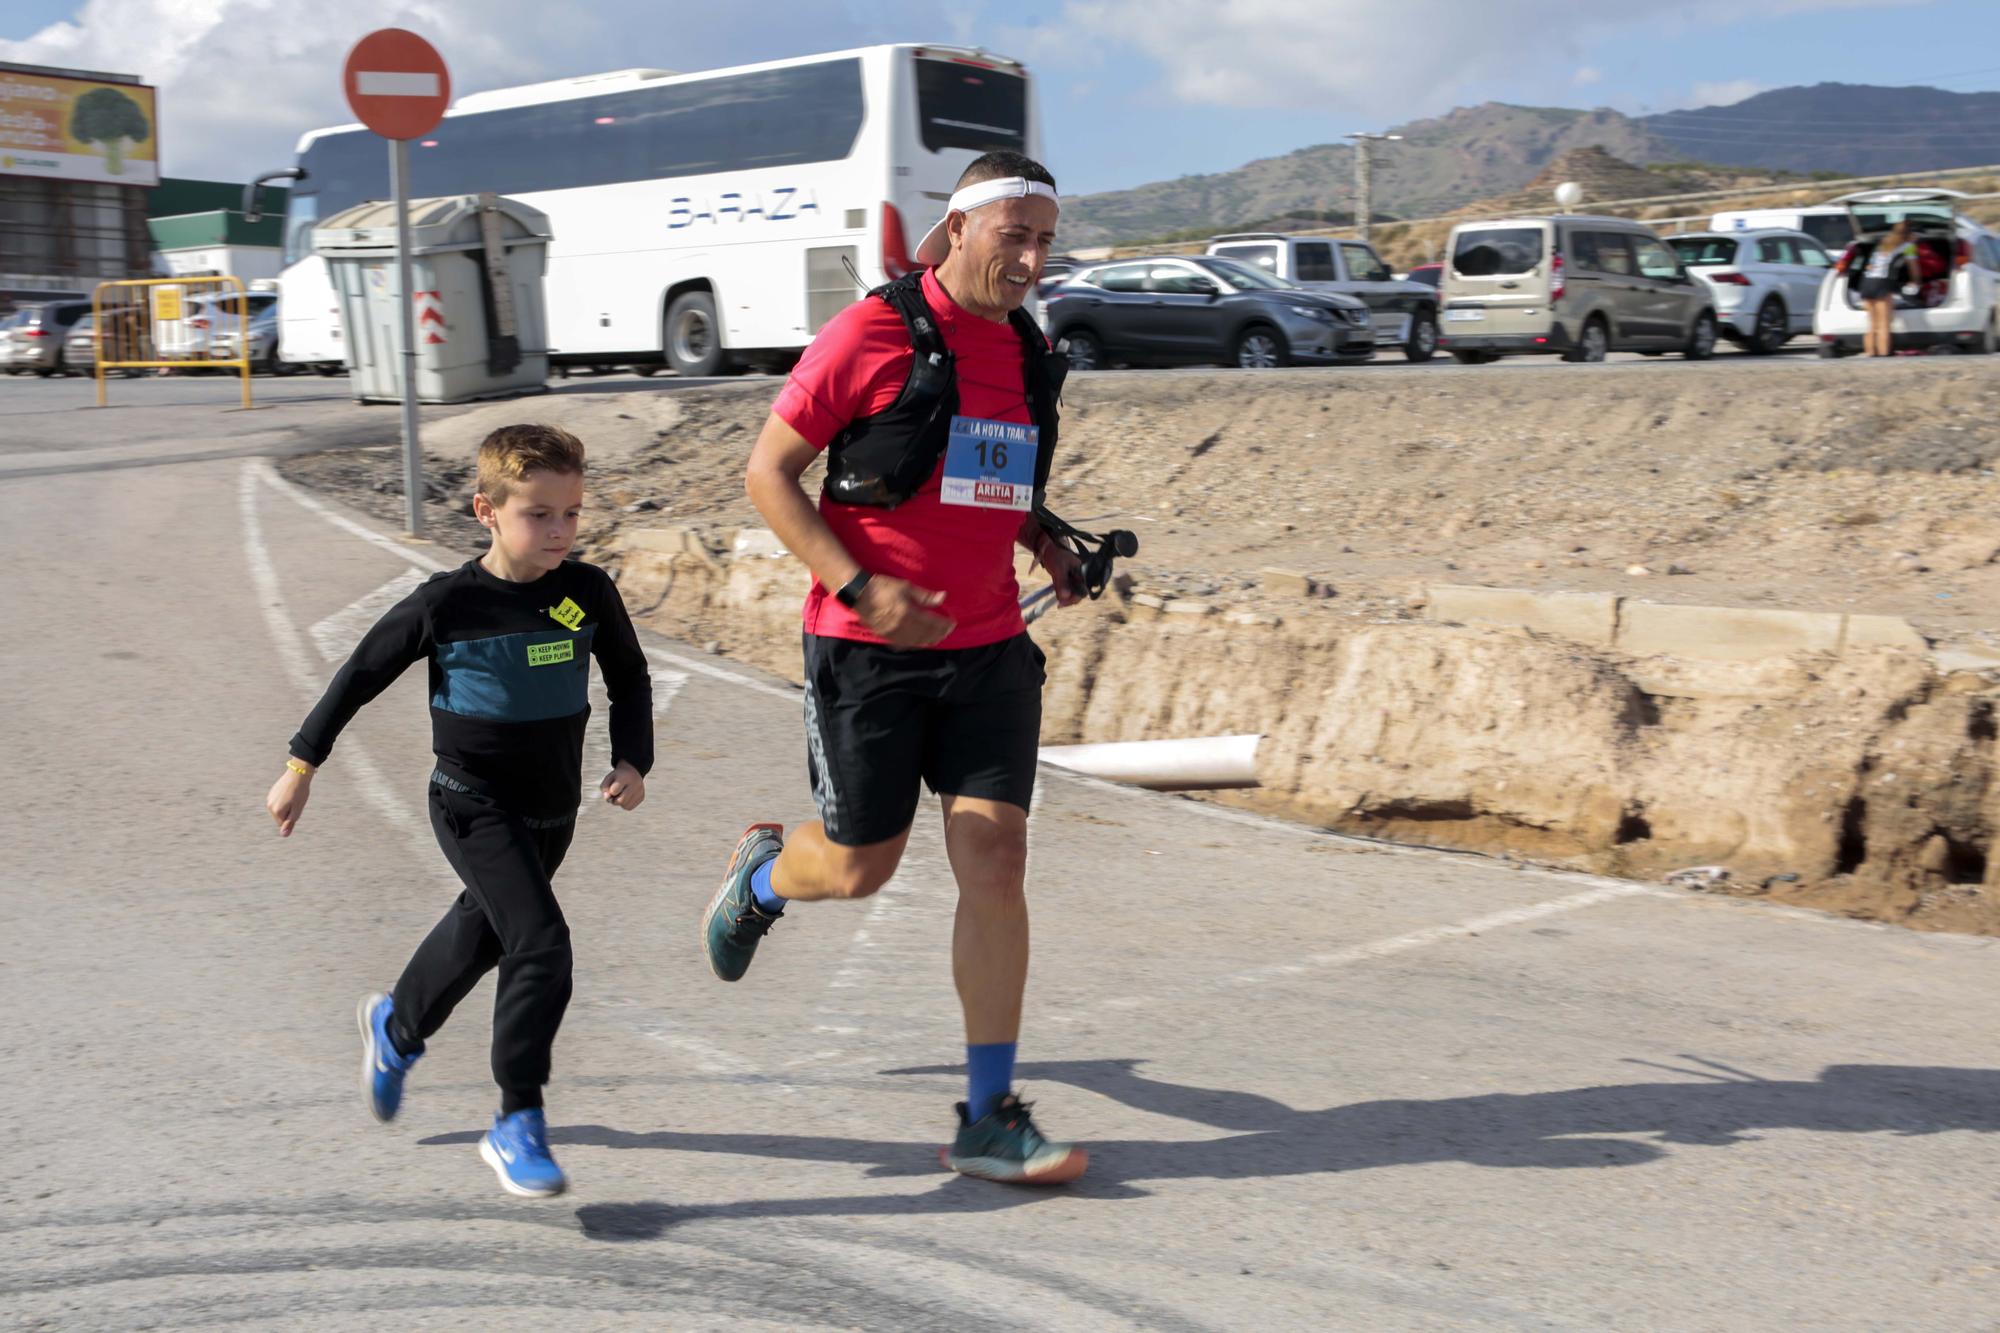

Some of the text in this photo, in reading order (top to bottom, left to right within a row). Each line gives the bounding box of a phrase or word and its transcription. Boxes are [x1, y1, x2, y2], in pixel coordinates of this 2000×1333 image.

[970, 422, 1026, 441] LA HOYA TRAIL
[975, 440, 1008, 470] 16
[977, 483, 1011, 498] ARETIA
[538, 645, 552, 653] KEEP
[539, 654, 553, 662] KEEP
